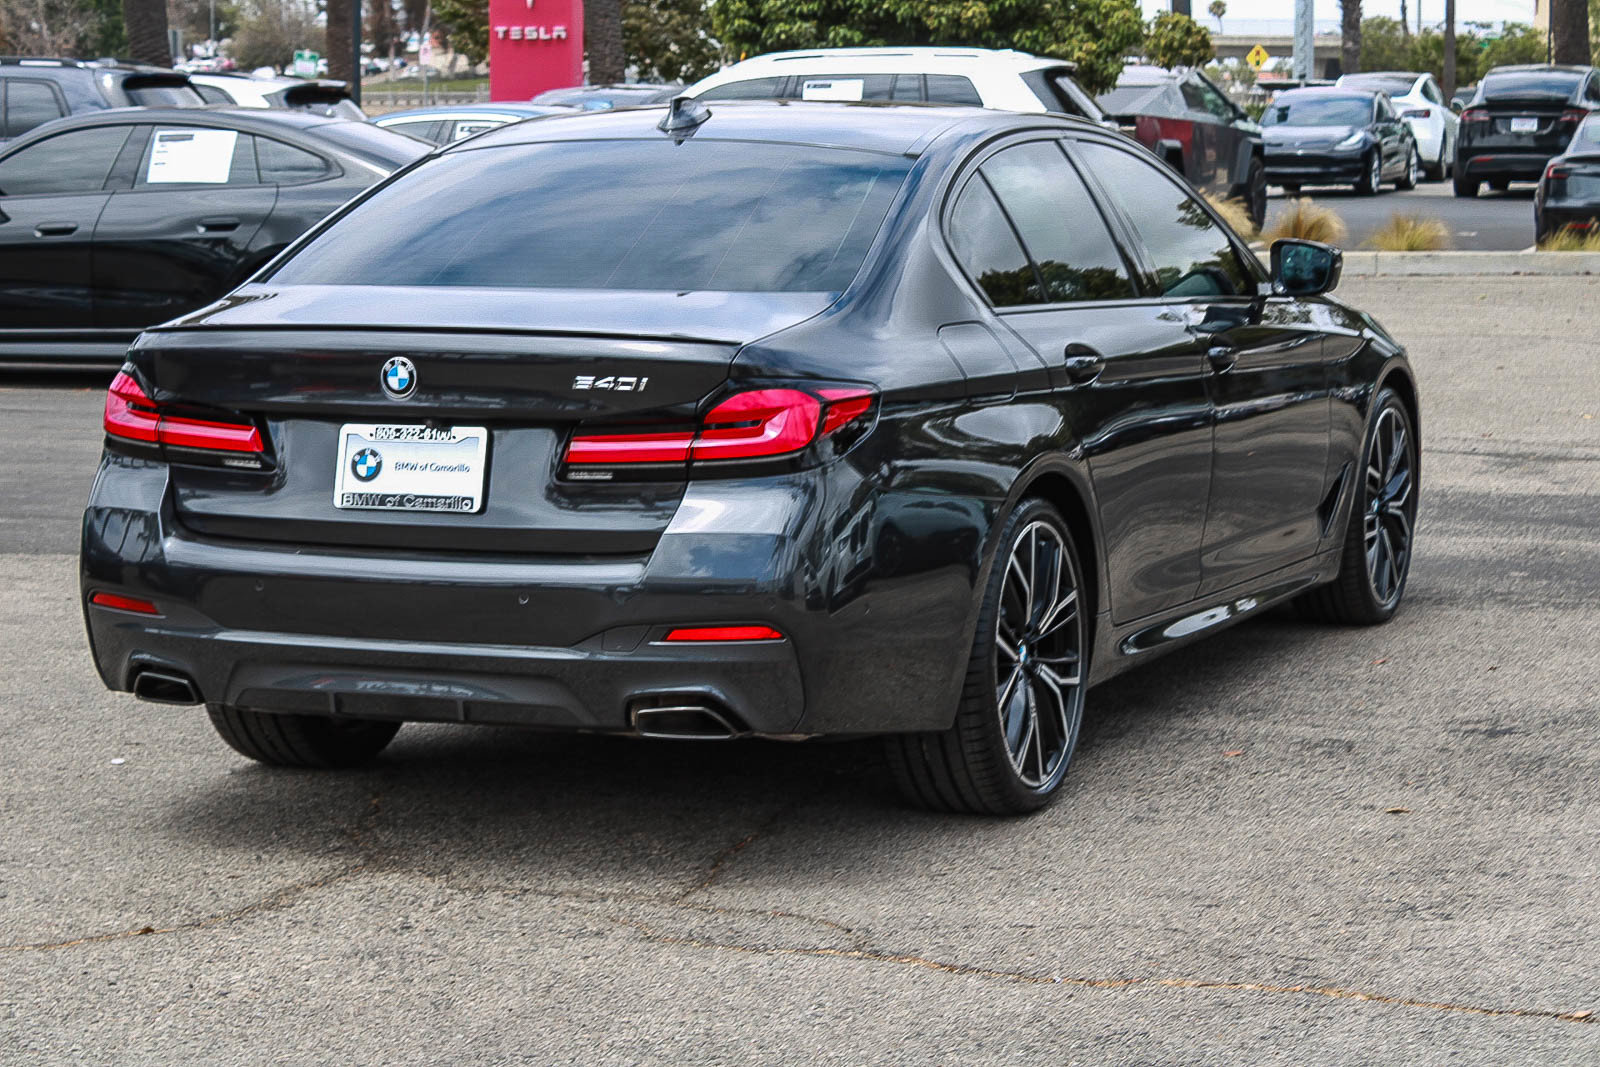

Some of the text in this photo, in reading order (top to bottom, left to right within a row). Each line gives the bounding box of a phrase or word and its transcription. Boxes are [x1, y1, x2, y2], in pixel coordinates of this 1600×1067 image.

[494, 26, 567, 40] TESLA
[395, 462, 470, 472] BMW of Camarillo
[343, 493, 472, 511] BMW of Camarillo
